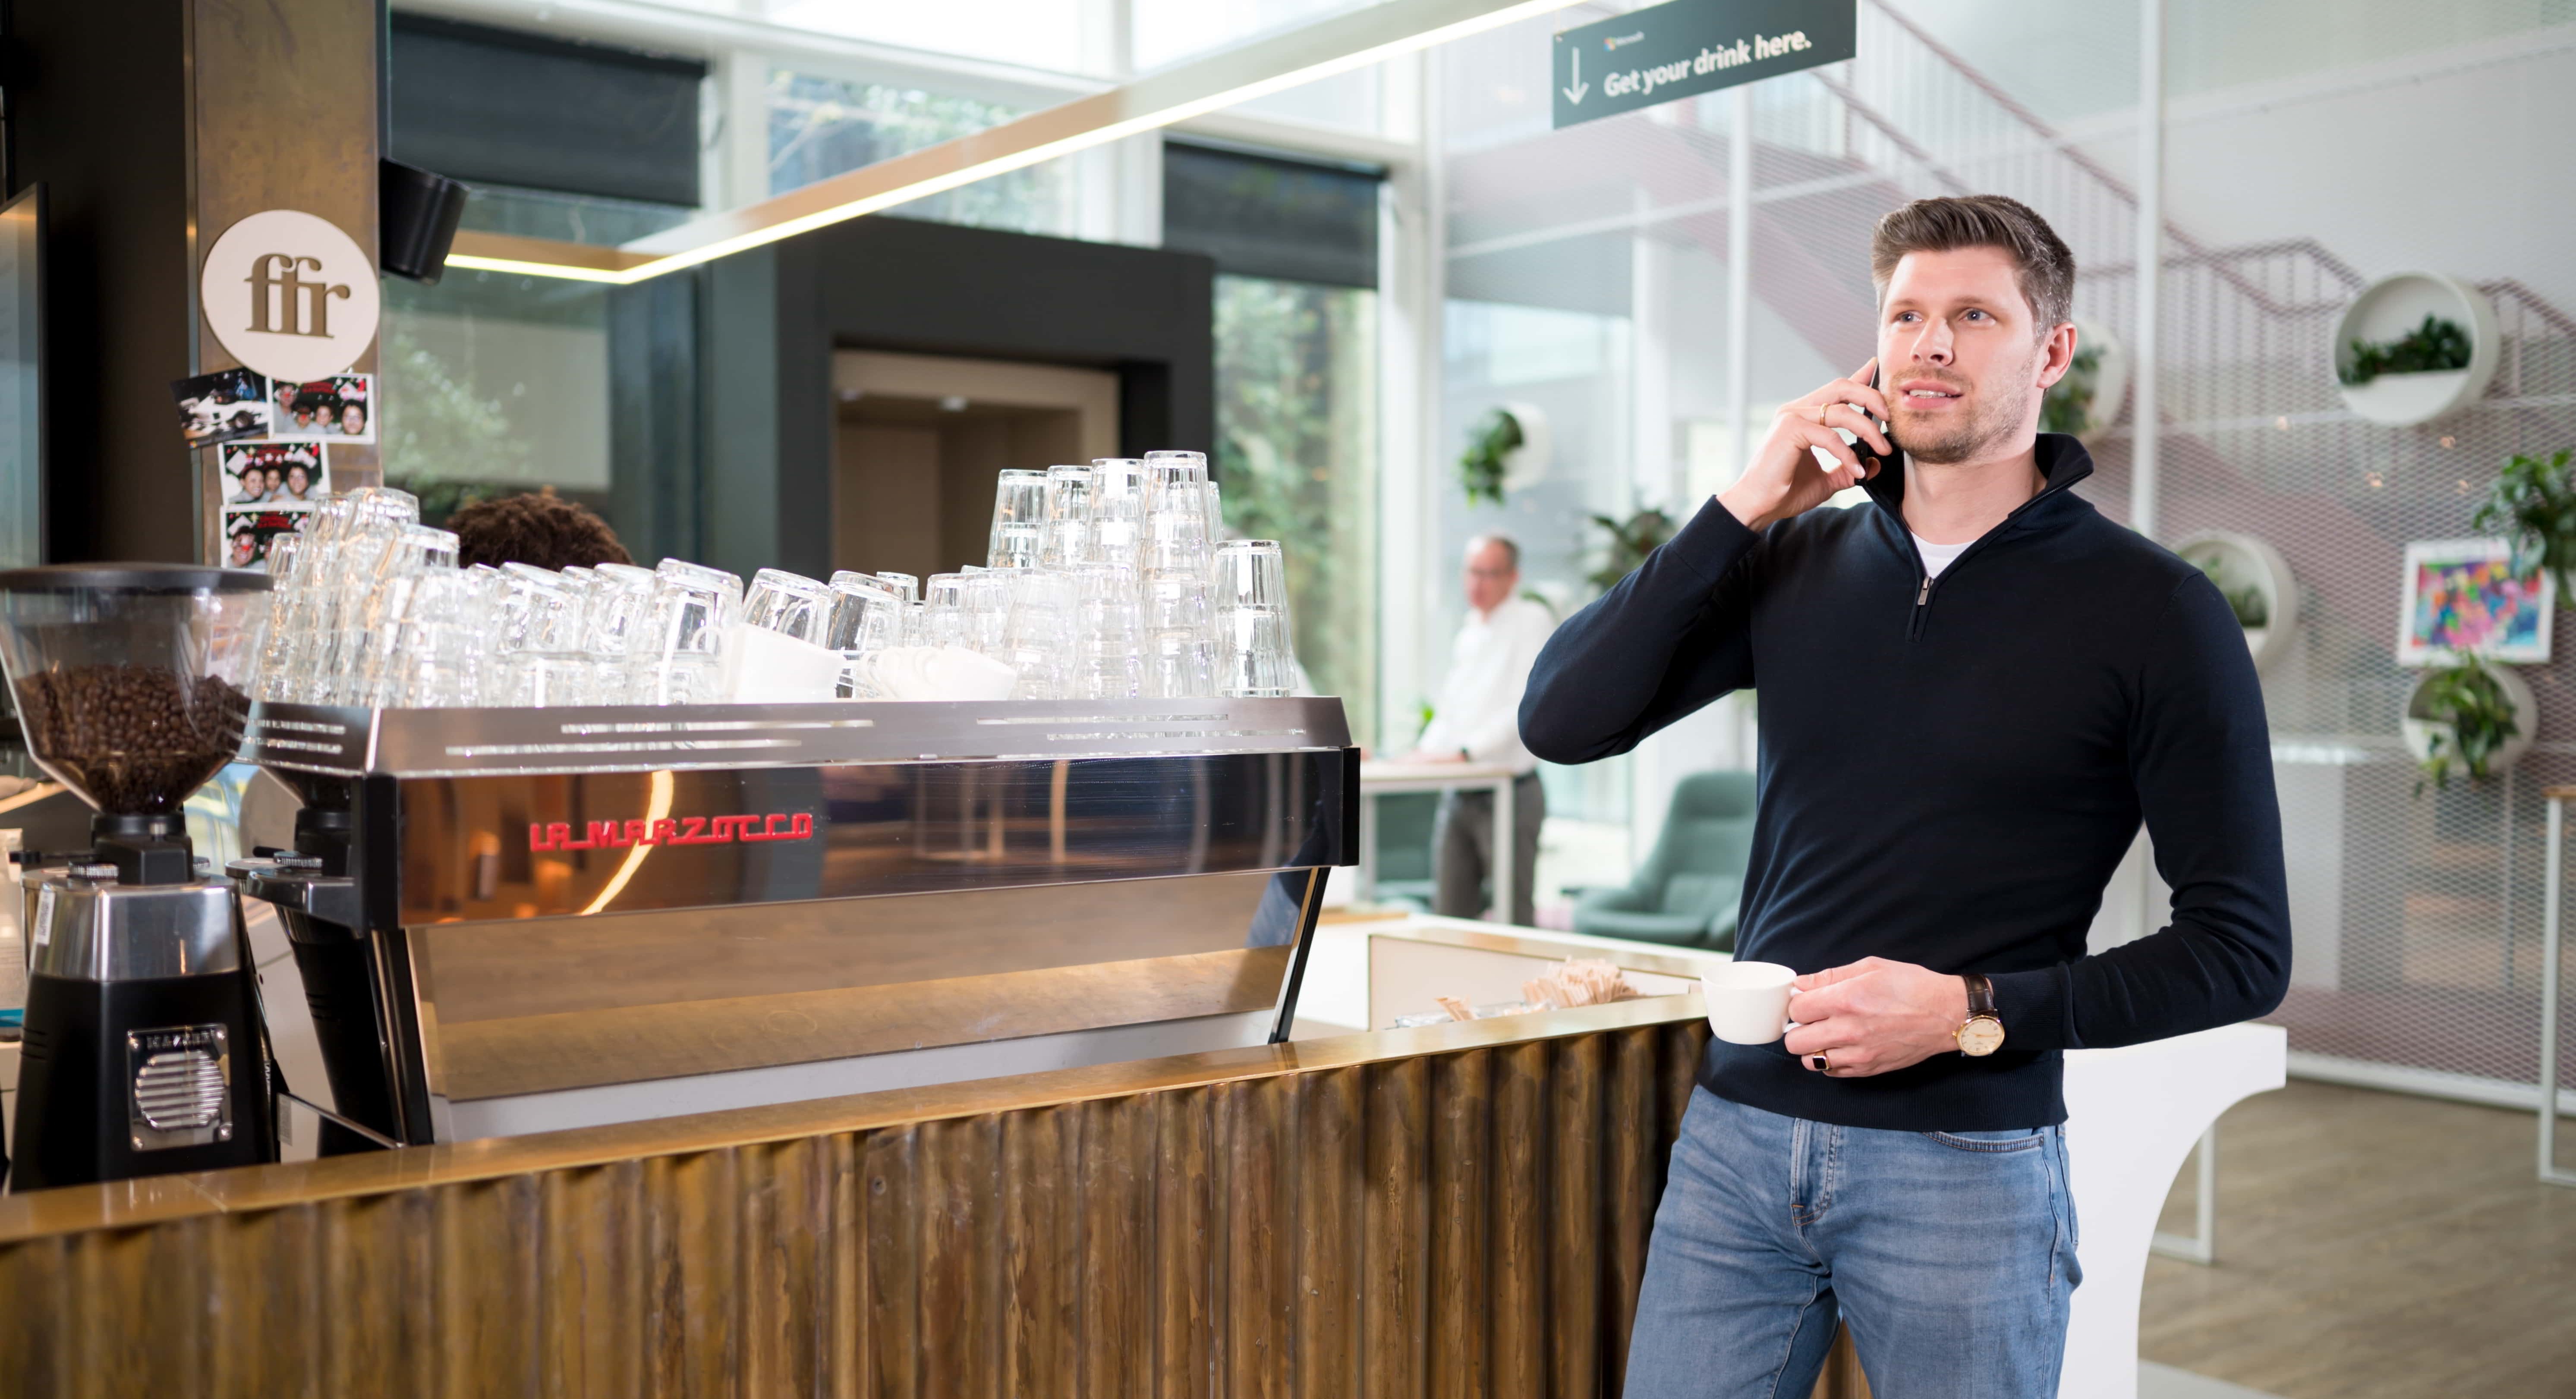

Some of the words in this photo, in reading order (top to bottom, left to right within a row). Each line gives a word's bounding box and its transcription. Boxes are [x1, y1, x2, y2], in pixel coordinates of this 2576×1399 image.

[1603, 72, 1641, 97] Get
[1641, 59, 1692, 95] your
[1693, 38, 1752, 75] drink
[1754, 30, 1812, 60] here.
[244, 252, 351, 339] ffr
[530, 821, 570, 852] LA
[587, 812, 813, 848] MARZOCCO
